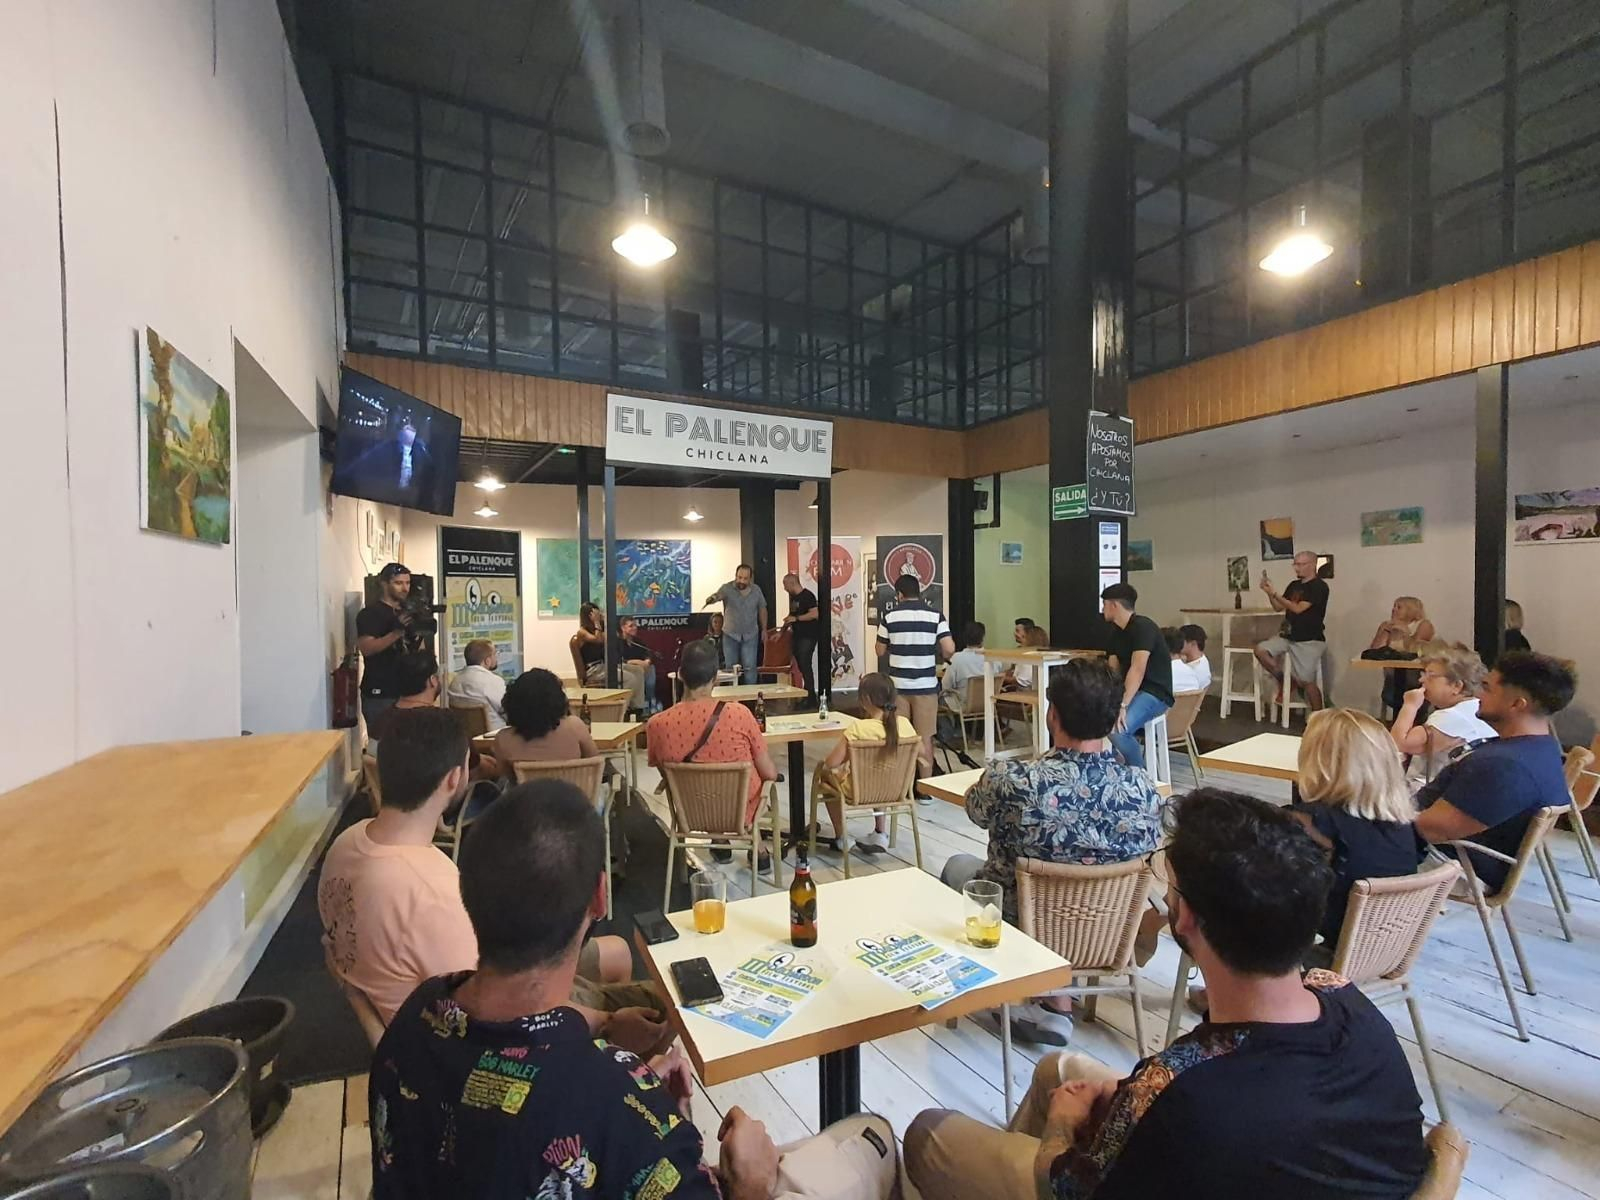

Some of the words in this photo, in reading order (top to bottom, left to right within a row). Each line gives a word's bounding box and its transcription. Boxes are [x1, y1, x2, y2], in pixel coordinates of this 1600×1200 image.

[615, 405, 652, 436] EL
[665, 412, 827, 453] PALENQUE
[1090, 423, 1128, 447] NOSOTROS
[686, 447, 769, 465] CHICLANA
[1091, 442, 1131, 463] APOSTAMOS
[1104, 457, 1118, 470] POR
[1055, 489, 1086, 503] SALIDA
[461, 555, 514, 567] PALENQUE
[641, 617, 689, 627] PALENQUE
